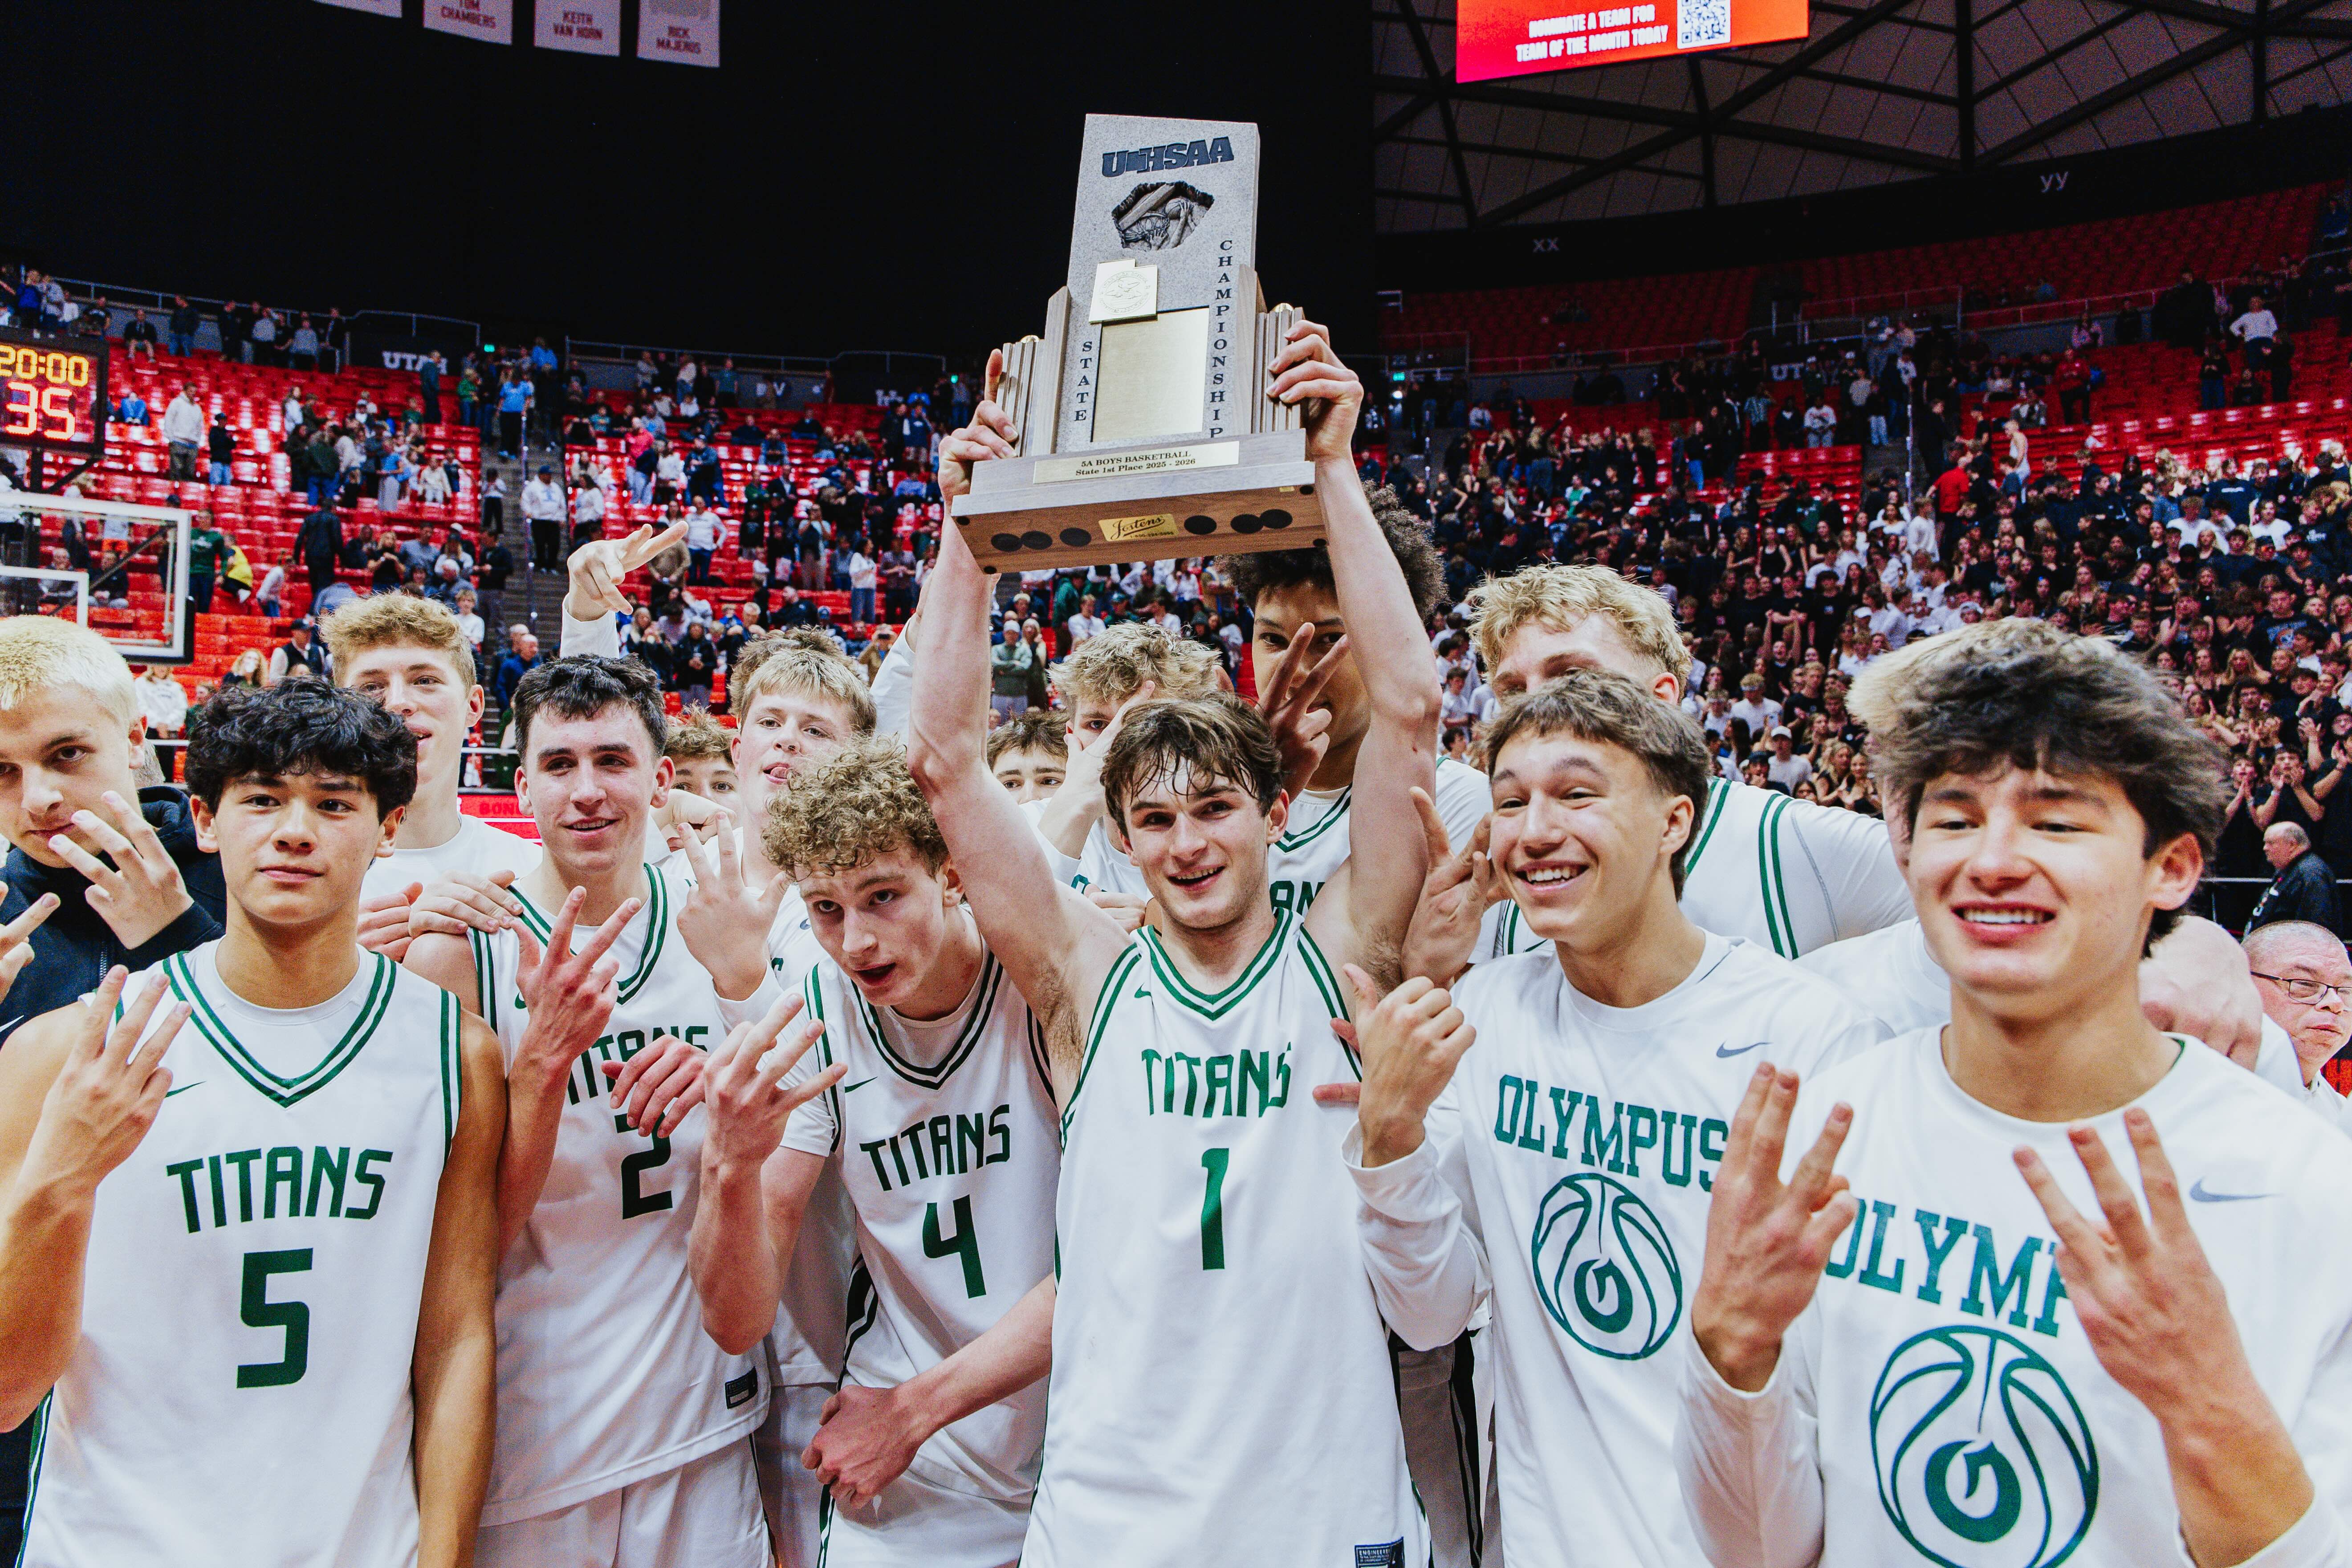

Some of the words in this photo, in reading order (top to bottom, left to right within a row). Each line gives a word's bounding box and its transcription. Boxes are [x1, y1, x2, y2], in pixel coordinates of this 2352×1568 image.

[440, 6, 496, 29] CHAMBERS
[553, 23, 573, 36] VAN
[576, 27, 603, 40] HORN
[563, 11, 593, 24] KEITH
[1515, 41, 1547, 61] TEAM
[1549, 39, 1564, 57] OF
[1566, 36, 1587, 55] THE
[1588, 30, 1630, 52] MONTH
[1632, 24, 1668, 46] TODAY
[1529, 14, 1586, 38] NOMINATE
[1587, 12, 1597, 30] A
[1598, 7, 1631, 28] TEAM
[1632, 4, 1655, 23] FOR
[0, 345, 89, 387] 20:00
[1209, 240, 1233, 438] CHAMPIONSHIP
[1770, 362, 1804, 381] UT
[5, 381, 75, 440] 35
[1074, 341, 1093, 421] STATE
[1096, 457, 1122, 466] BOYS
[1125, 451, 1191, 463] BASKETBALL
[1111, 517, 1165, 540] Jostens
[480, 802, 521, 815] BON
[1141, 1042, 1291, 1118] TITANS
[614, 1111, 673, 1220] 2
[859, 1104, 1010, 1191] TITANS
[1494, 1074, 1729, 1193] OLYMPUS
[167, 1146, 393, 1233] TITANS
[1201, 1148, 1229, 1271] 1
[923, 1194, 987, 1299] 4
[1825, 1198, 2070, 1337] OLYMP
[237, 1248, 313, 1389] 5
